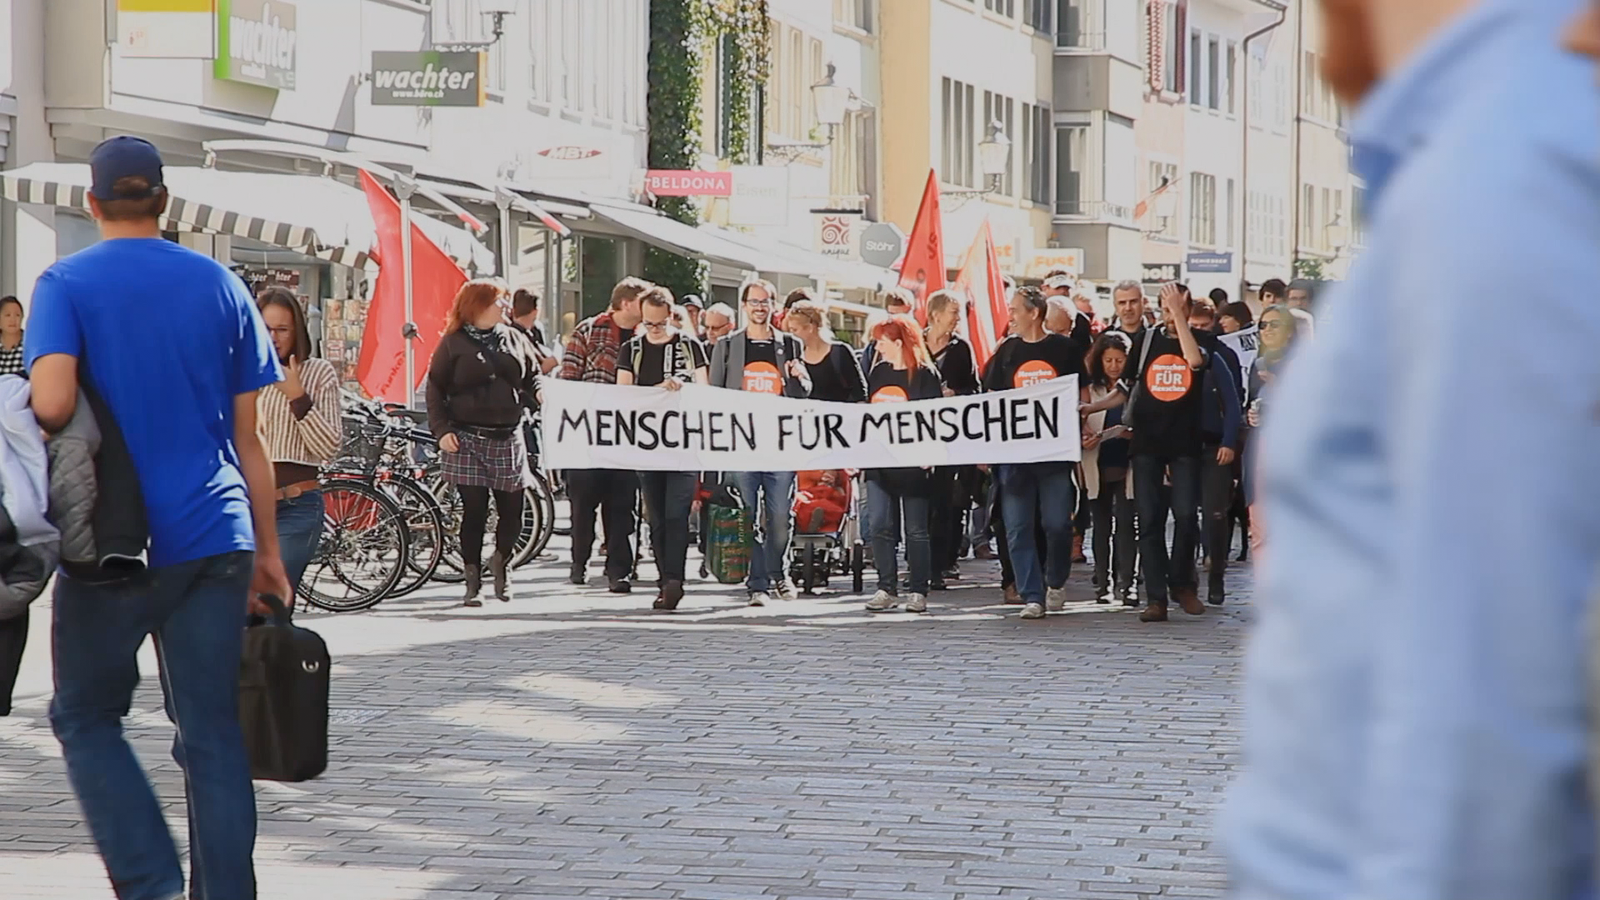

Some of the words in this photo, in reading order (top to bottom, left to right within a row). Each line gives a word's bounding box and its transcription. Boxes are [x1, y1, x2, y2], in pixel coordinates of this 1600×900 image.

[375, 63, 475, 89] wachter
[651, 176, 726, 190] BELDONA
[865, 240, 895, 251] Stöhr
[746, 377, 774, 391] FÜR
[1155, 370, 1183, 385] FÜR
[557, 408, 757, 452] MENSCHEN
[777, 408, 851, 452] FÜR
[859, 396, 1060, 445] MENSCHEN
